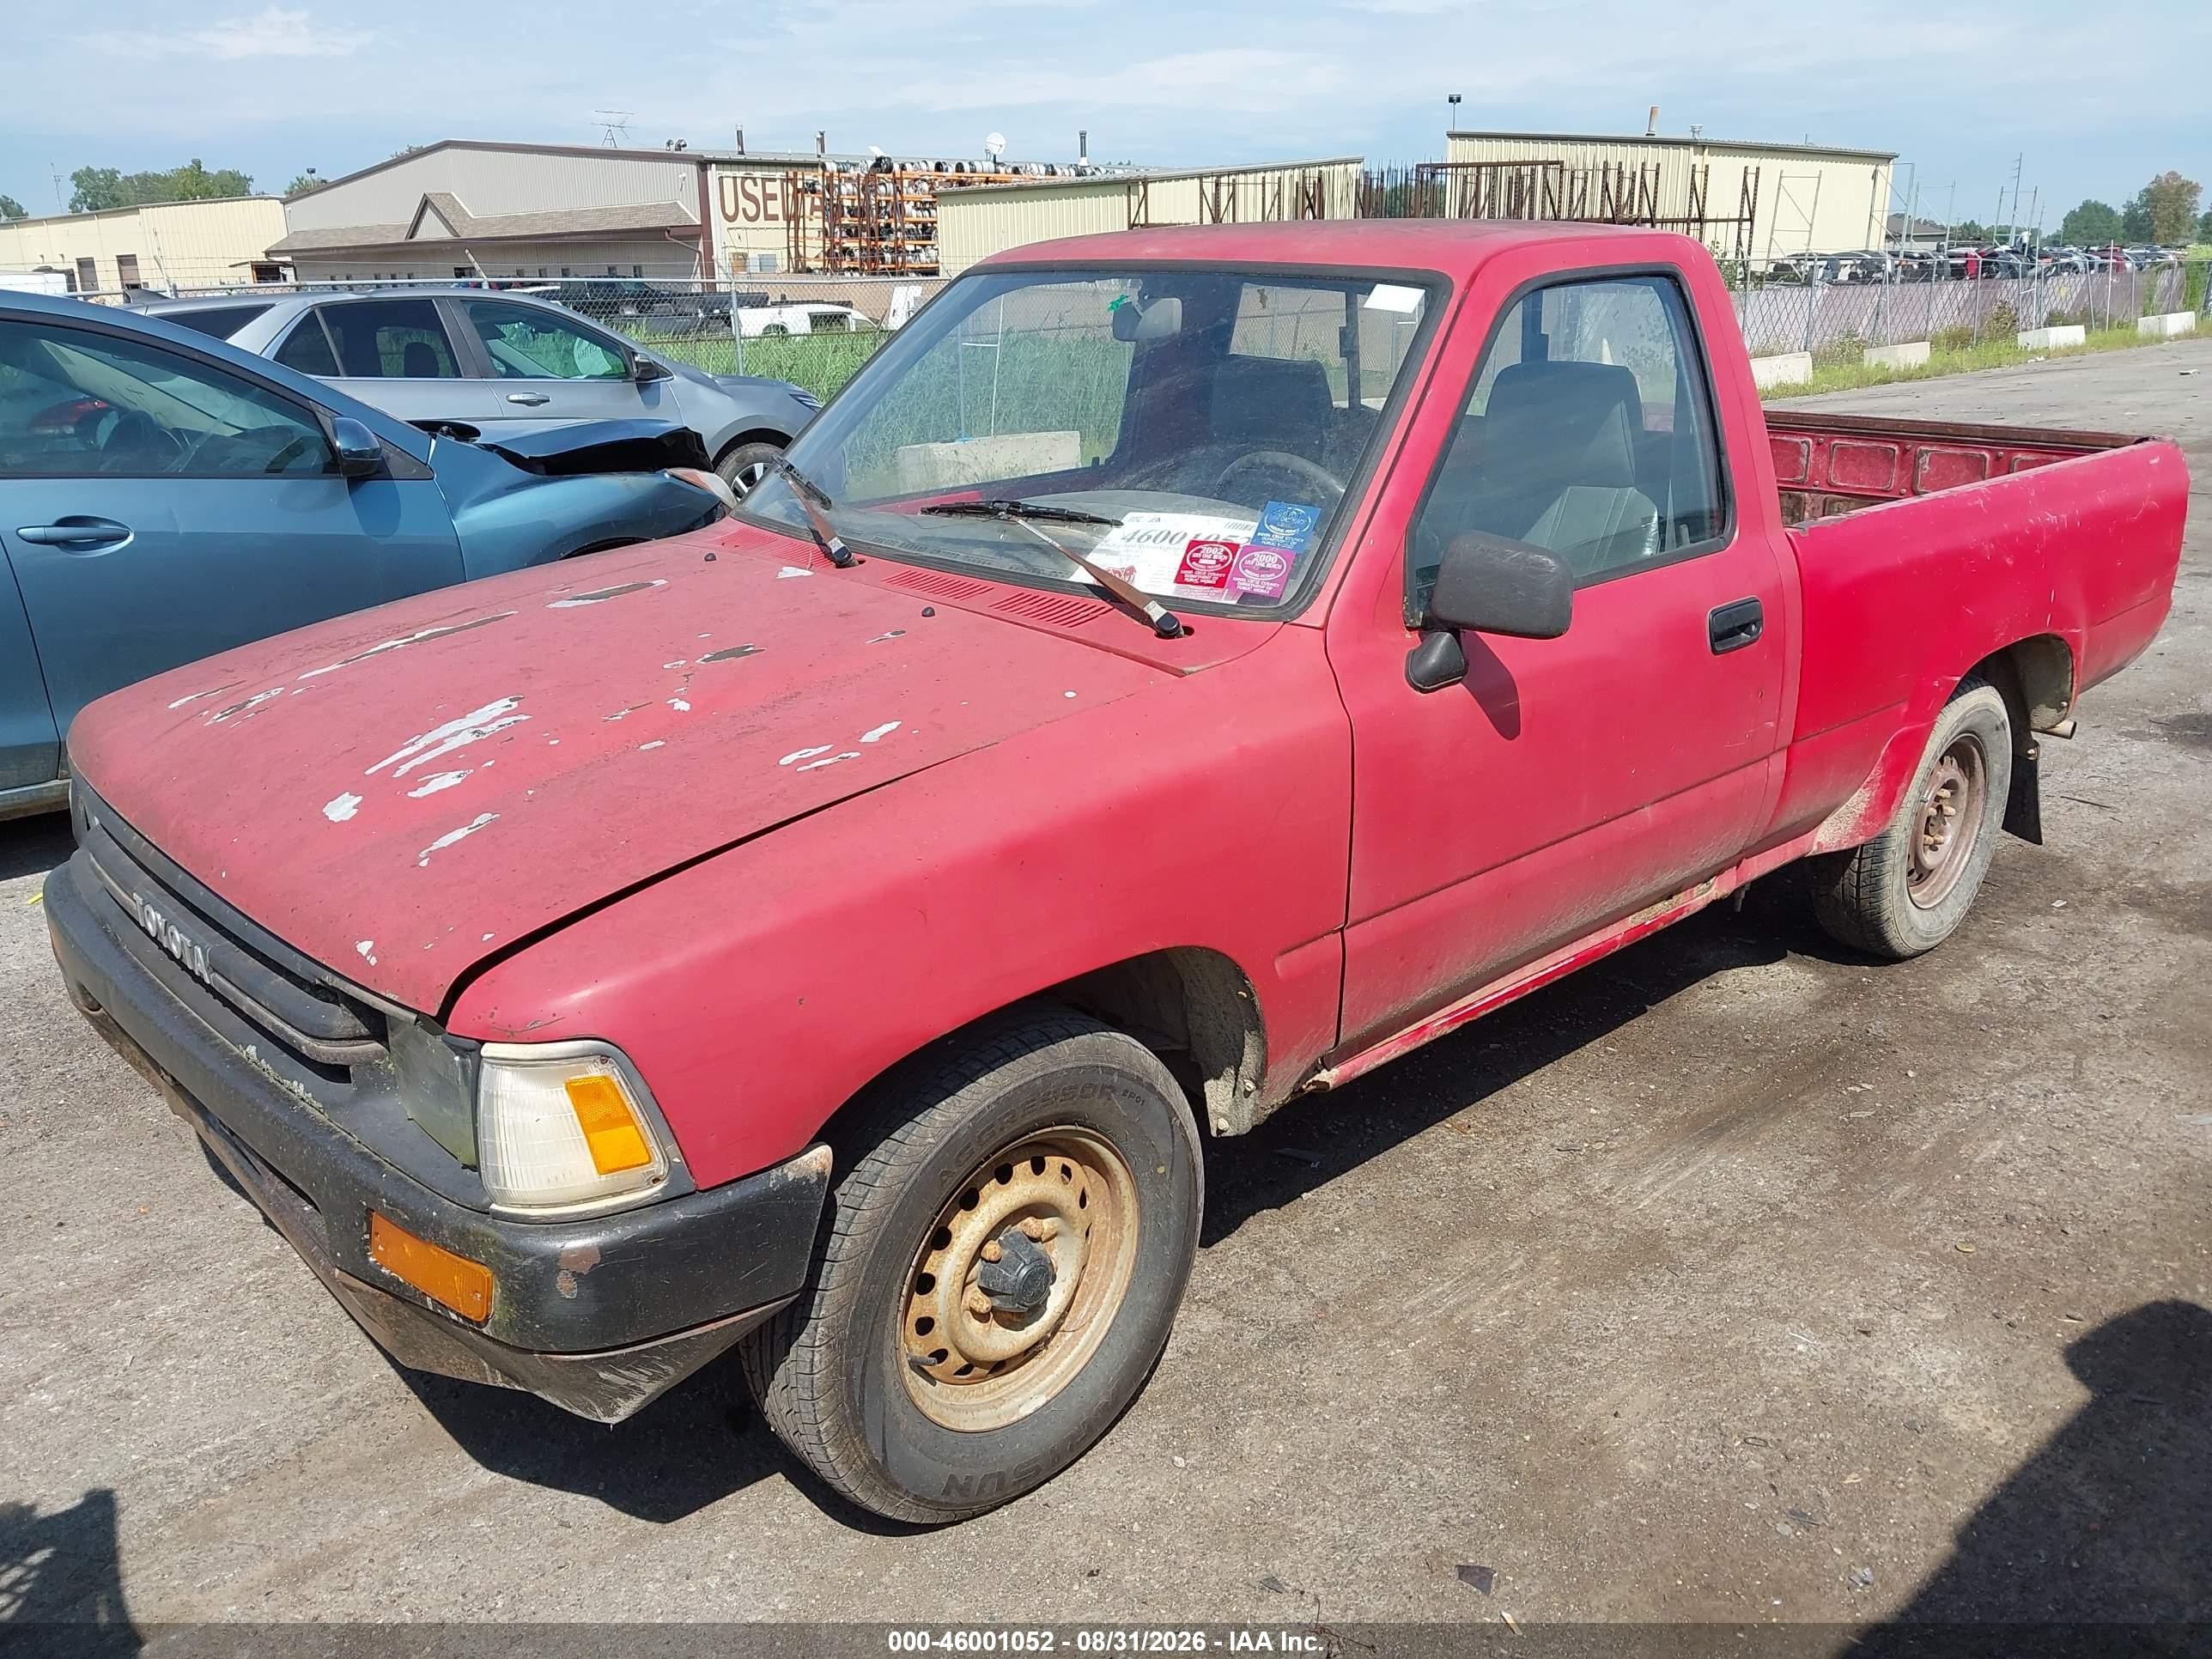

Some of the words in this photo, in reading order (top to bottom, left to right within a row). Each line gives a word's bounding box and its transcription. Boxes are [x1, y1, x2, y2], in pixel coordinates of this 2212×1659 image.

[718, 173, 796, 222] USED
[1200, 546, 1224, 555] 2002
[1254, 554, 1278, 564] 2000
[132, 891, 211, 984] TOYOTA
